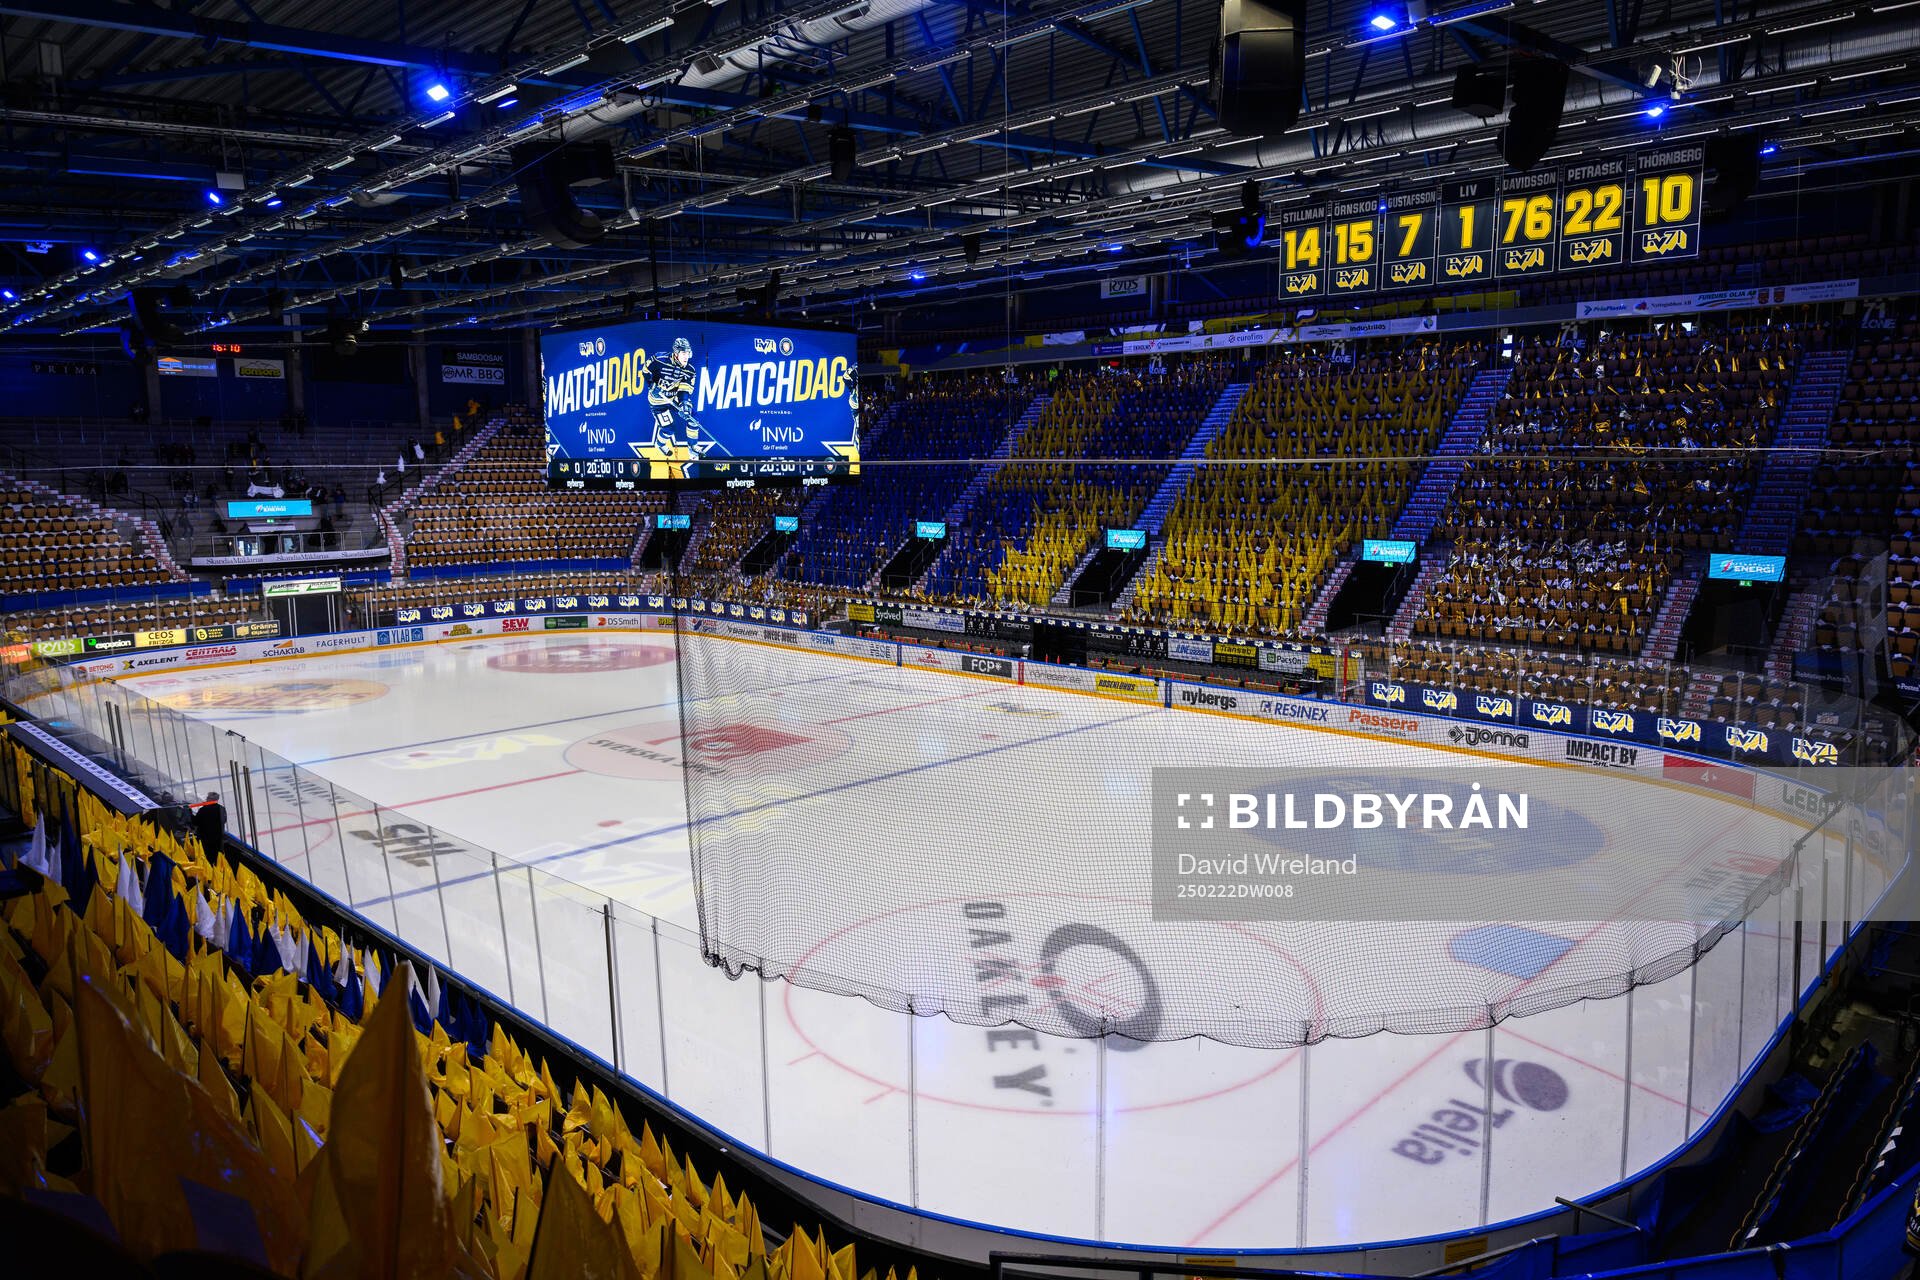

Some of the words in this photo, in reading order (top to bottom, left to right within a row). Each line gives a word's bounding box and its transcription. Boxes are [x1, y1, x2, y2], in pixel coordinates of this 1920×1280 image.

[1638, 147, 1702, 169] THÖRNBERG
[1567, 160, 1624, 181] PETRASEK
[1459, 184, 1478, 198] LIV
[1503, 172, 1556, 191] DAVIDSSON
[1333, 197, 1379, 217] ÖRNSKOG
[1387, 191, 1436, 209] GUSTAFSSON
[1643, 174, 1694, 225] 10
[1283, 206, 1325, 224] STILLMAN
[1502, 195, 1553, 244] 76
[1564, 185, 1623, 236] 22
[1398, 214, 1423, 257] 7
[1459, 205, 1475, 249] 1
[1284, 227, 1321, 270] 14
[1335, 220, 1374, 263] 15
[1570, 238, 1614, 263] HV71
[1642, 229, 1688, 255] HV71
[1446, 254, 1482, 278] HV71
[1505, 247, 1544, 271] HV71
[1286, 273, 1317, 294] HV71
[1336, 269, 1368, 289] HV71
[1391, 262, 1426, 284] HV71
[1109, 280, 1138, 292] RYDS
[1237, 334, 1263, 342] eurofins
[34, 365, 97, 375] PRIMA
[478, 369, 504, 380] BBQ
[547, 348, 646, 418] MATCHDAG
[697, 356, 848, 412] MATCHDAG
[587, 428, 616, 444] INVID
[762, 426, 804, 443] INVID
[586, 462, 611, 474] 20:00
[760, 461, 795, 472] 20:00
[727, 478, 755, 488] nybergs
[803, 477, 829, 486] nybergs
[1735, 566, 1775, 574] ENERGI
[502, 618, 529, 628] SEW
[618, 617, 639, 626] Smith
[876, 610, 901, 621] Sydved
[148, 631, 173, 640] CEOS
[316, 636, 365, 648] FAGERHULT
[392, 629, 410, 644] YLAB
[816, 636, 834, 645] STENA
[137, 656, 179, 667] AXELENT
[262, 647, 305, 658] SCHAKTAB
[1182, 688, 1237, 709] nybergs
[1372, 682, 1405, 703] HV71
[1423, 688, 1457, 711] HV71
[1274, 703, 1328, 722] RESINEX
[1476, 695, 1513, 718] HV71
[1532, 702, 1572, 726] HV71
[1349, 709, 1419, 732] Passera
[1593, 708, 1634, 734] HV71
[1657, 717, 1702, 743] HV71
[1726, 725, 1768, 753] HV71
[588, 739, 677, 763] SVENSKA
[1566, 740, 1617, 763] IMPACT
[1619, 747, 1638, 765] BY
[1791, 736, 1839, 765] HV71
[962, 901, 1053, 1097] OAKLEY
[1391, 1098, 1515, 1165] Telia
